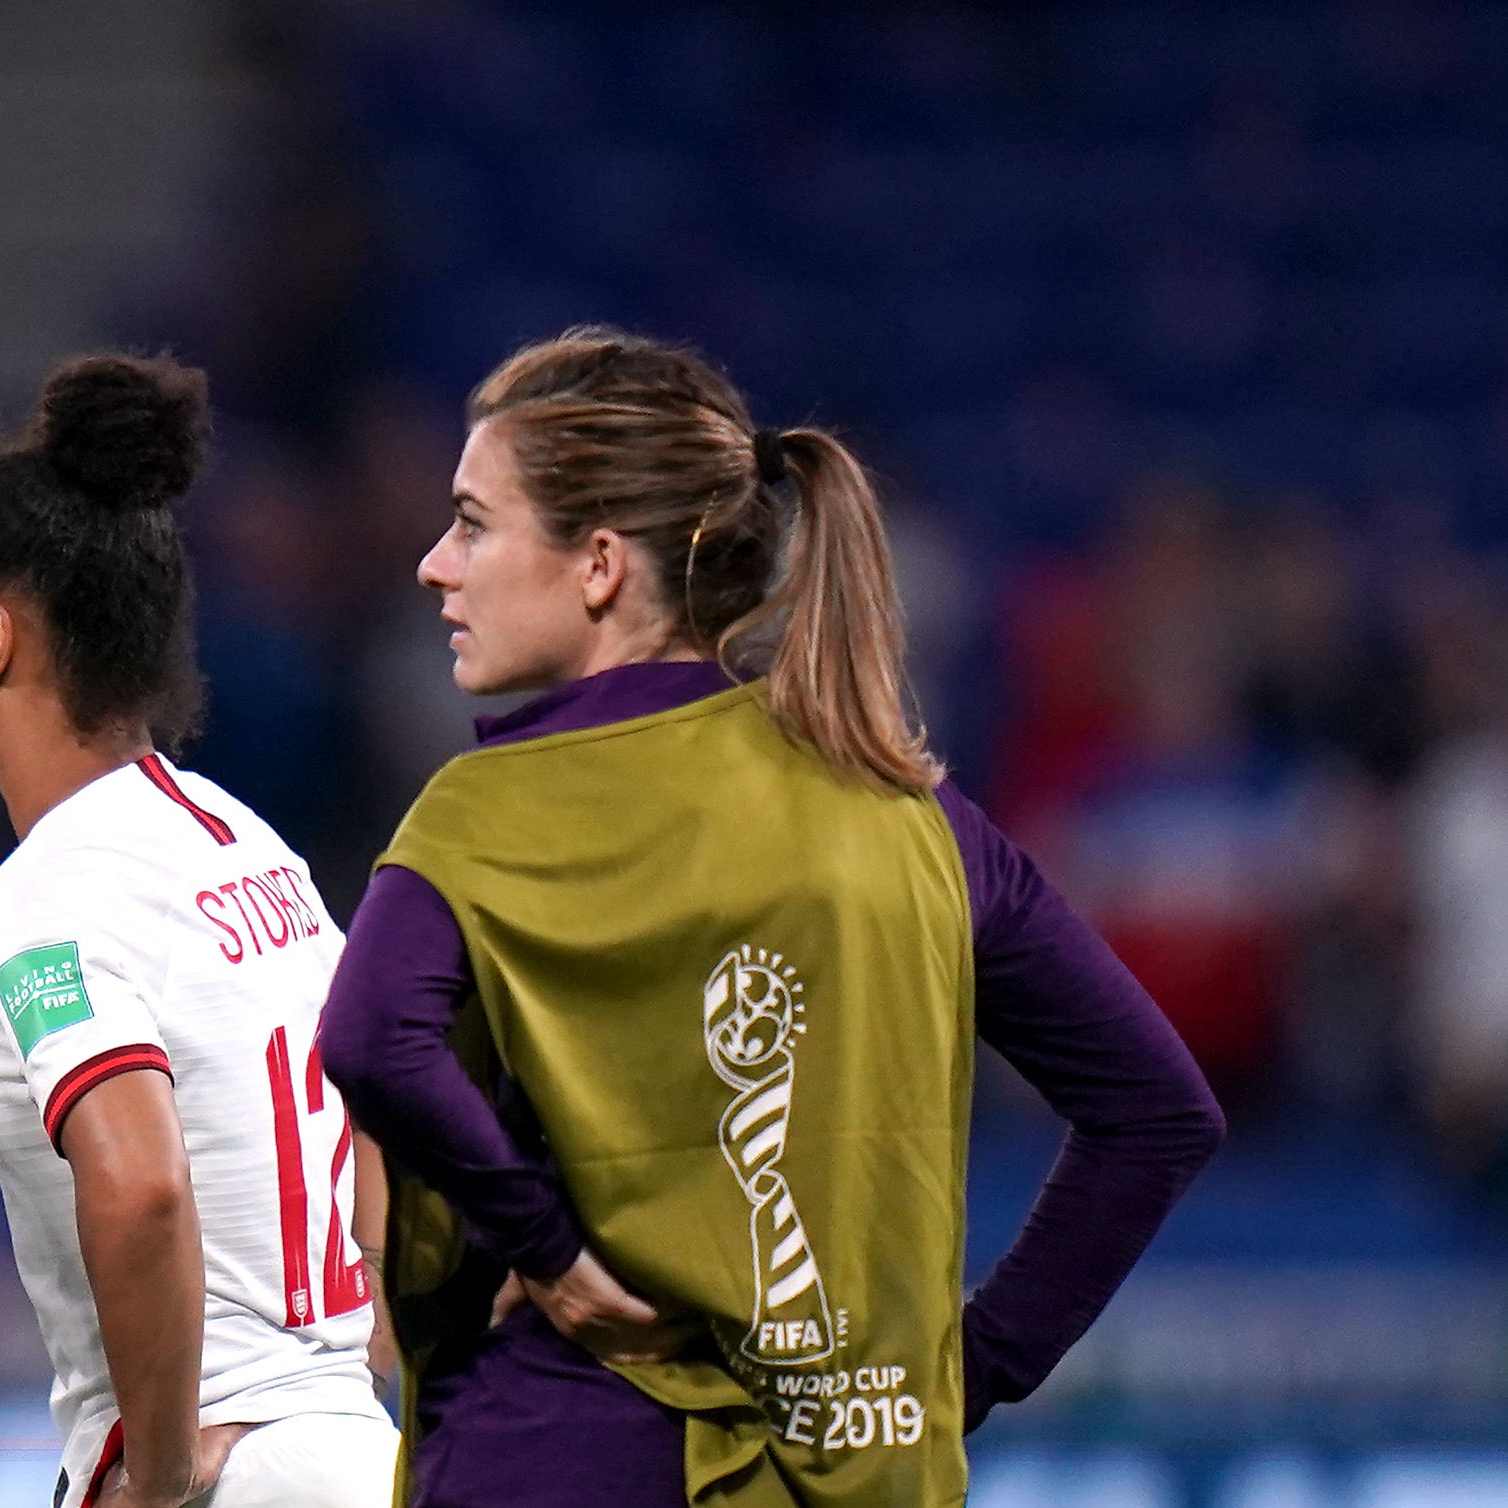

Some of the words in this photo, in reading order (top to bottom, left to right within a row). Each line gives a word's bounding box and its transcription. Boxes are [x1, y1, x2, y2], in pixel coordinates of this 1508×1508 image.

[5, 961, 73, 1003] LIVING
[9, 970, 74, 1014] FOOTBALL
[42, 991, 80, 1010] FIFA
[265, 1006, 374, 1328] 12
[758, 1319, 823, 1350] FIFA
[855, 1365, 907, 1391] CUP
[823, 1394, 926, 1450] 2019
